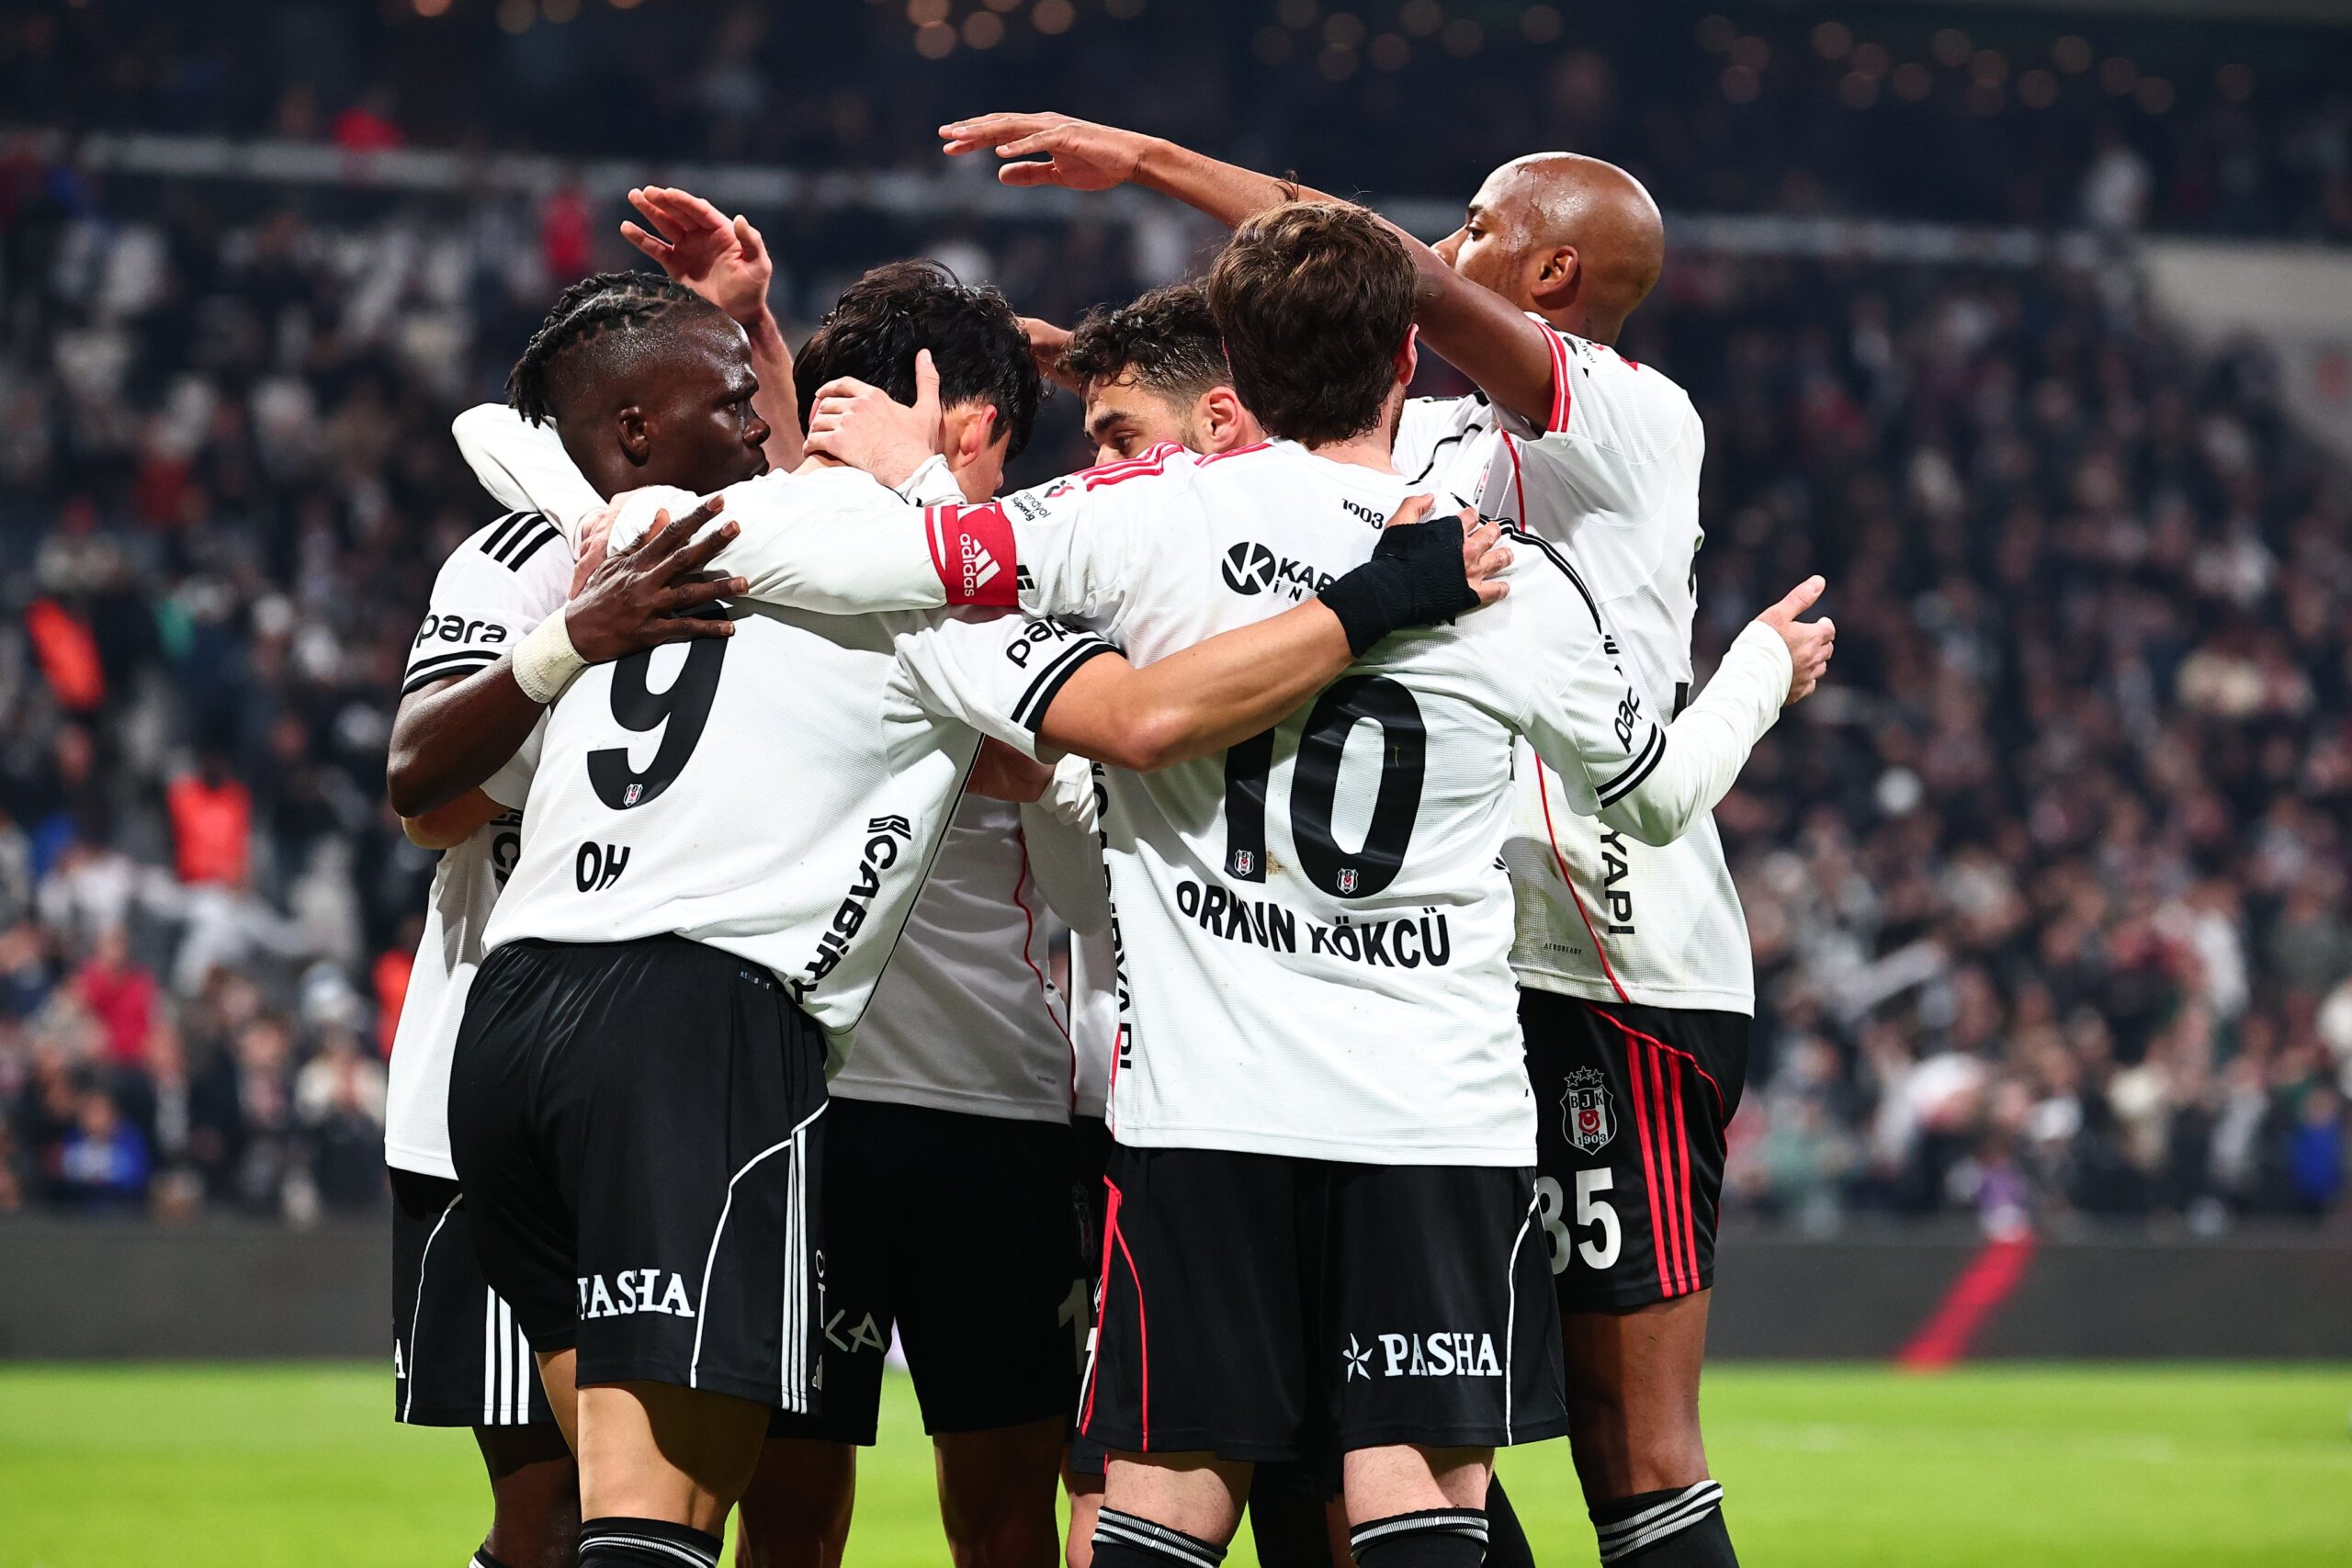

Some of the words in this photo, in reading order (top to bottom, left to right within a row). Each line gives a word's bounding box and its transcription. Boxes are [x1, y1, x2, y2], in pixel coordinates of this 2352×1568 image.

[1341, 498, 1385, 530] 1903
[959, 533, 976, 597] adidas
[416, 615, 507, 649] para
[587, 600, 732, 810] 9
[1225, 673, 1427, 899] 10
[576, 842, 630, 893] OH
[1177, 880, 1296, 953] ORKUN
[1306, 907, 1451, 969] KÖKCÜ
[1577, 1133, 1608, 1145] 1903
[1378, 1332, 1503, 1377] PASHA
